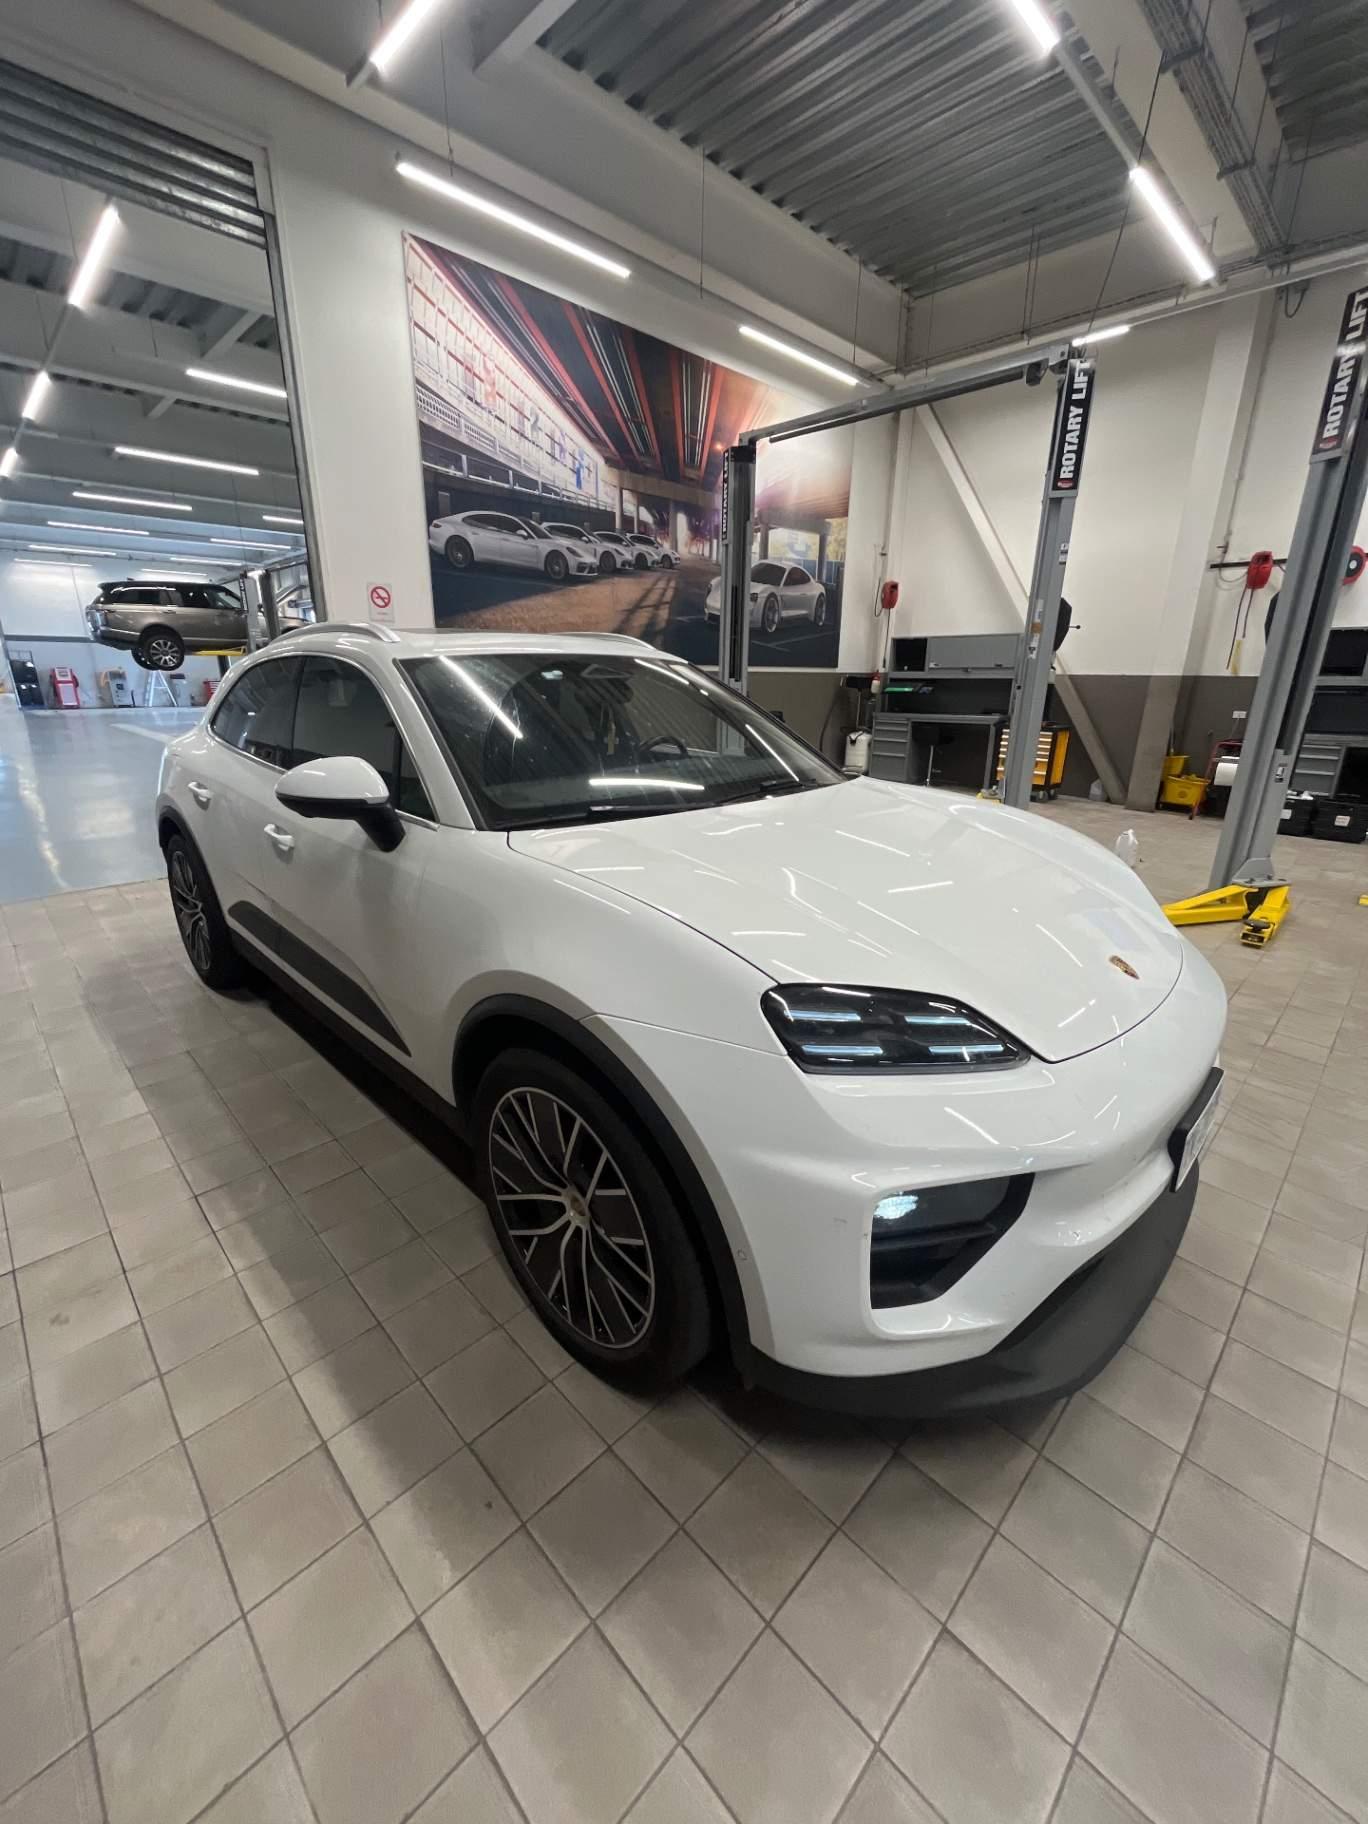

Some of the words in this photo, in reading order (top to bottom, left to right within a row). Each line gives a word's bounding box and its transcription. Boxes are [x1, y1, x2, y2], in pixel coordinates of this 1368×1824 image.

[1346, 292, 1368, 341] LIFT
[1060, 406, 1083, 479] ROTARY
[1072, 360, 1090, 400] LIFT
